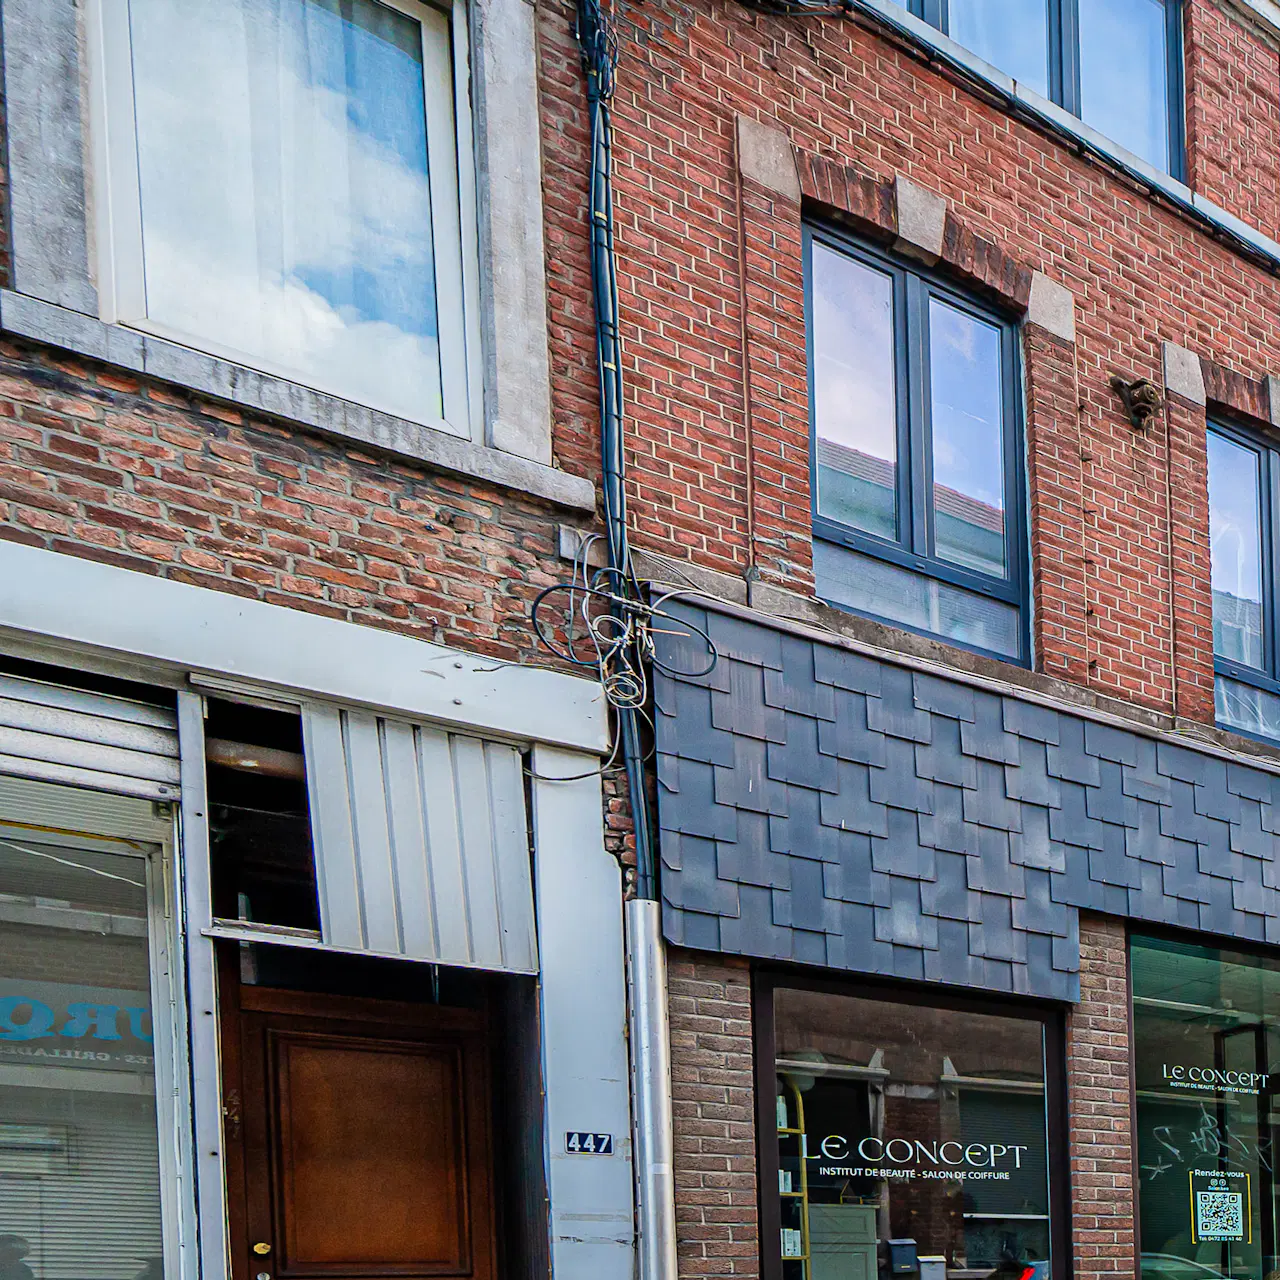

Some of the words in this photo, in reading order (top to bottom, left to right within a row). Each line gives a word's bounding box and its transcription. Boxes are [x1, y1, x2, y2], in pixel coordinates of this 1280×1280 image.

[1162, 1063, 1186, 1080] LE
[1188, 1066, 1270, 1088] CONCEPT
[568, 1132, 611, 1153] 447
[801, 1133, 850, 1161] LE
[858, 1136, 1028, 1169] CONCEPT
[818, 1166, 864, 1178] INSTITUT
[864, 1167, 878, 1177] DE
[879, 1167, 917, 1179] BEAUTÉ
[922, 1169, 954, 1179] SALON
[954, 1171, 967, 1180] DE
[967, 1171, 1010, 1180] COIFFURE
[1194, 1168, 1245, 1178] Rendez-vous
